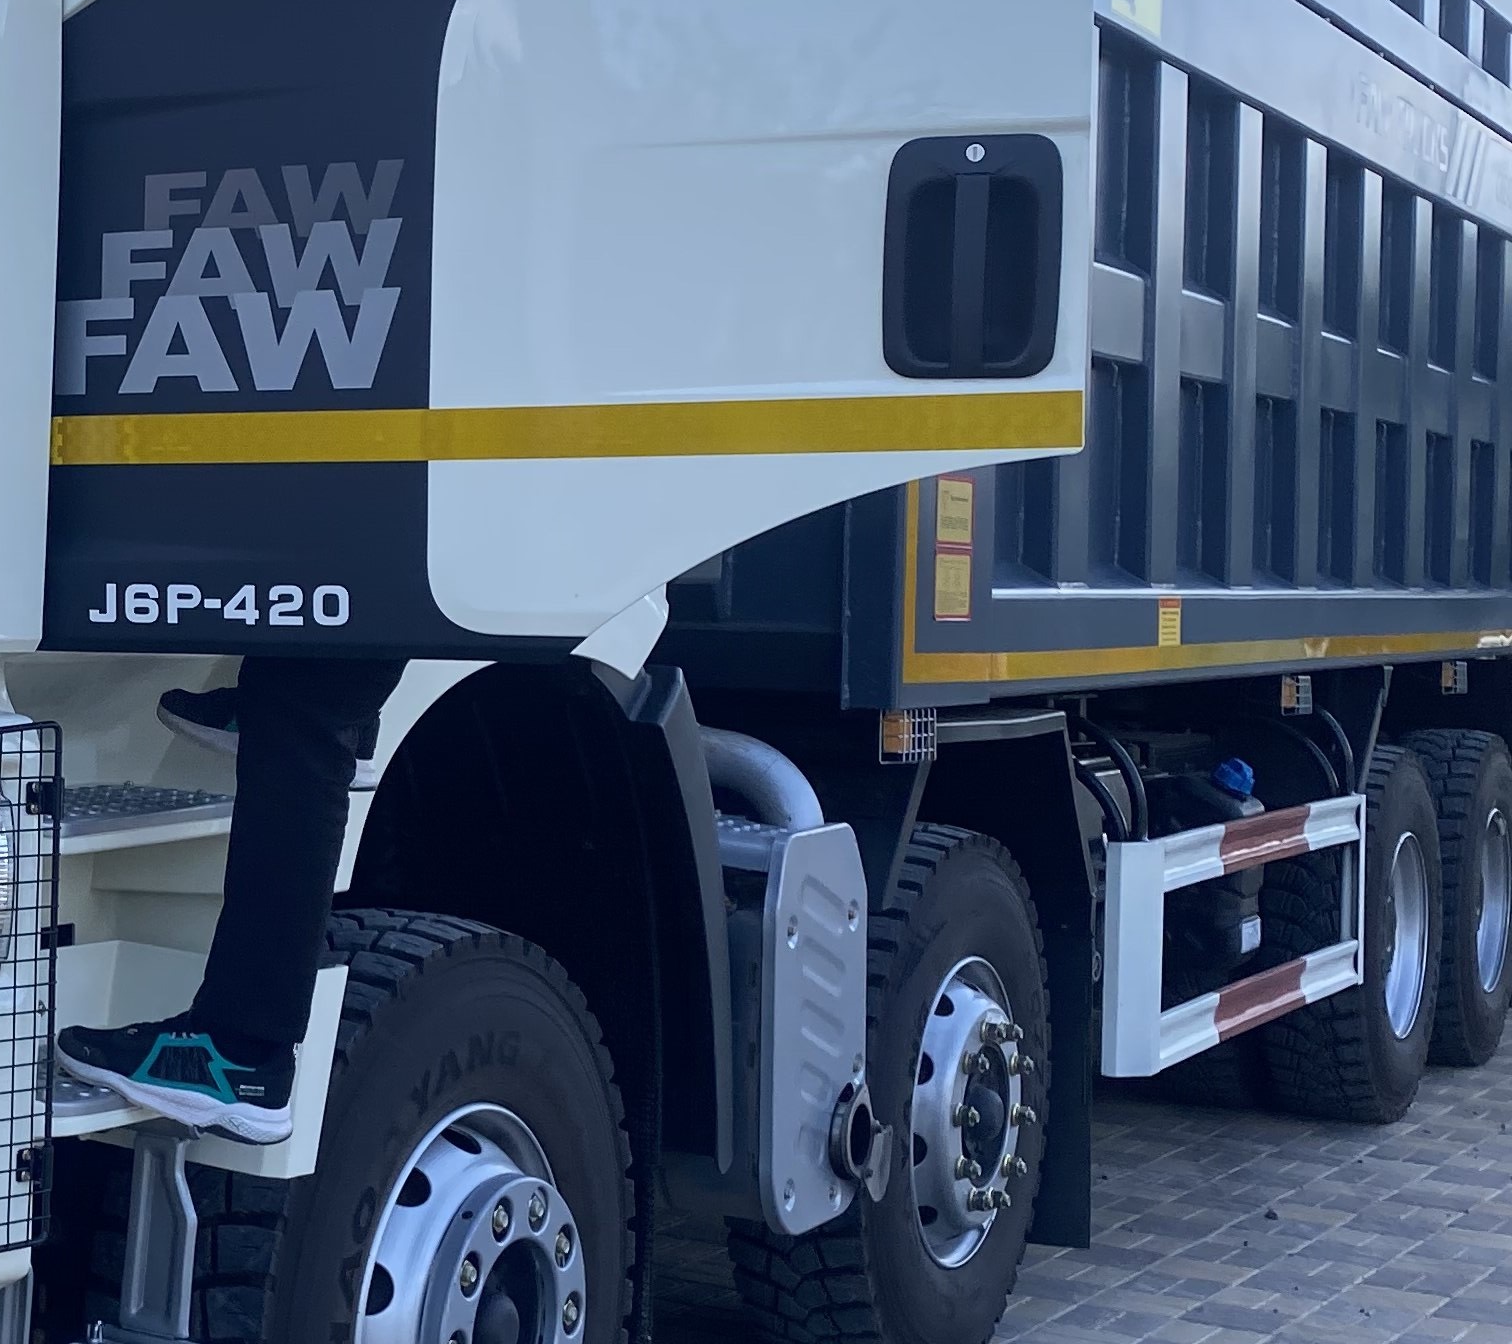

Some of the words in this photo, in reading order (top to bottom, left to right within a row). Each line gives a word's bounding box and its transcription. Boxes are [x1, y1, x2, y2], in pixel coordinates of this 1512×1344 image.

[144, 159, 404, 238] FAW
[101, 218, 402, 309] FAW
[55, 287, 401, 395] FAW
[89, 583, 350, 626] J6P-420
[410, 1031, 520, 1118] YANG
